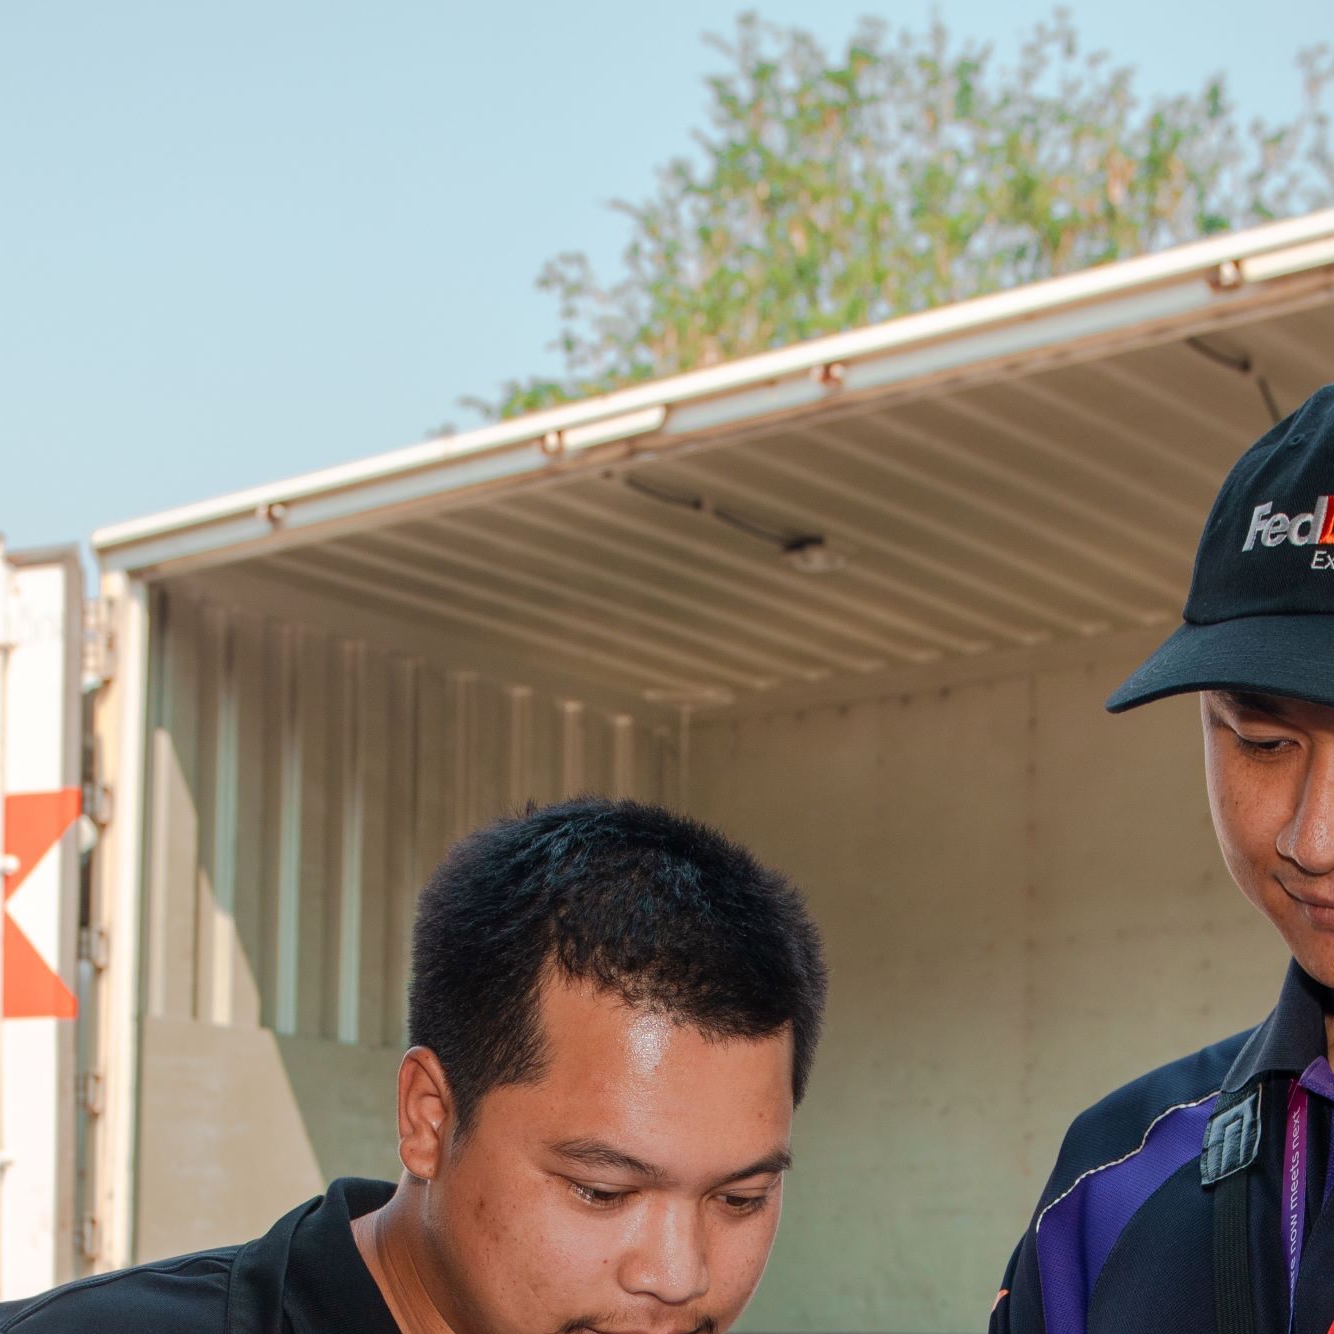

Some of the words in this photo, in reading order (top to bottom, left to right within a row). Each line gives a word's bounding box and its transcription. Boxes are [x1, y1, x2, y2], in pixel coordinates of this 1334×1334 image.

[1292, 1106, 1301, 1150] next
[1290, 1151, 1300, 1211] meets
[1290, 1214, 1298, 1256] now
